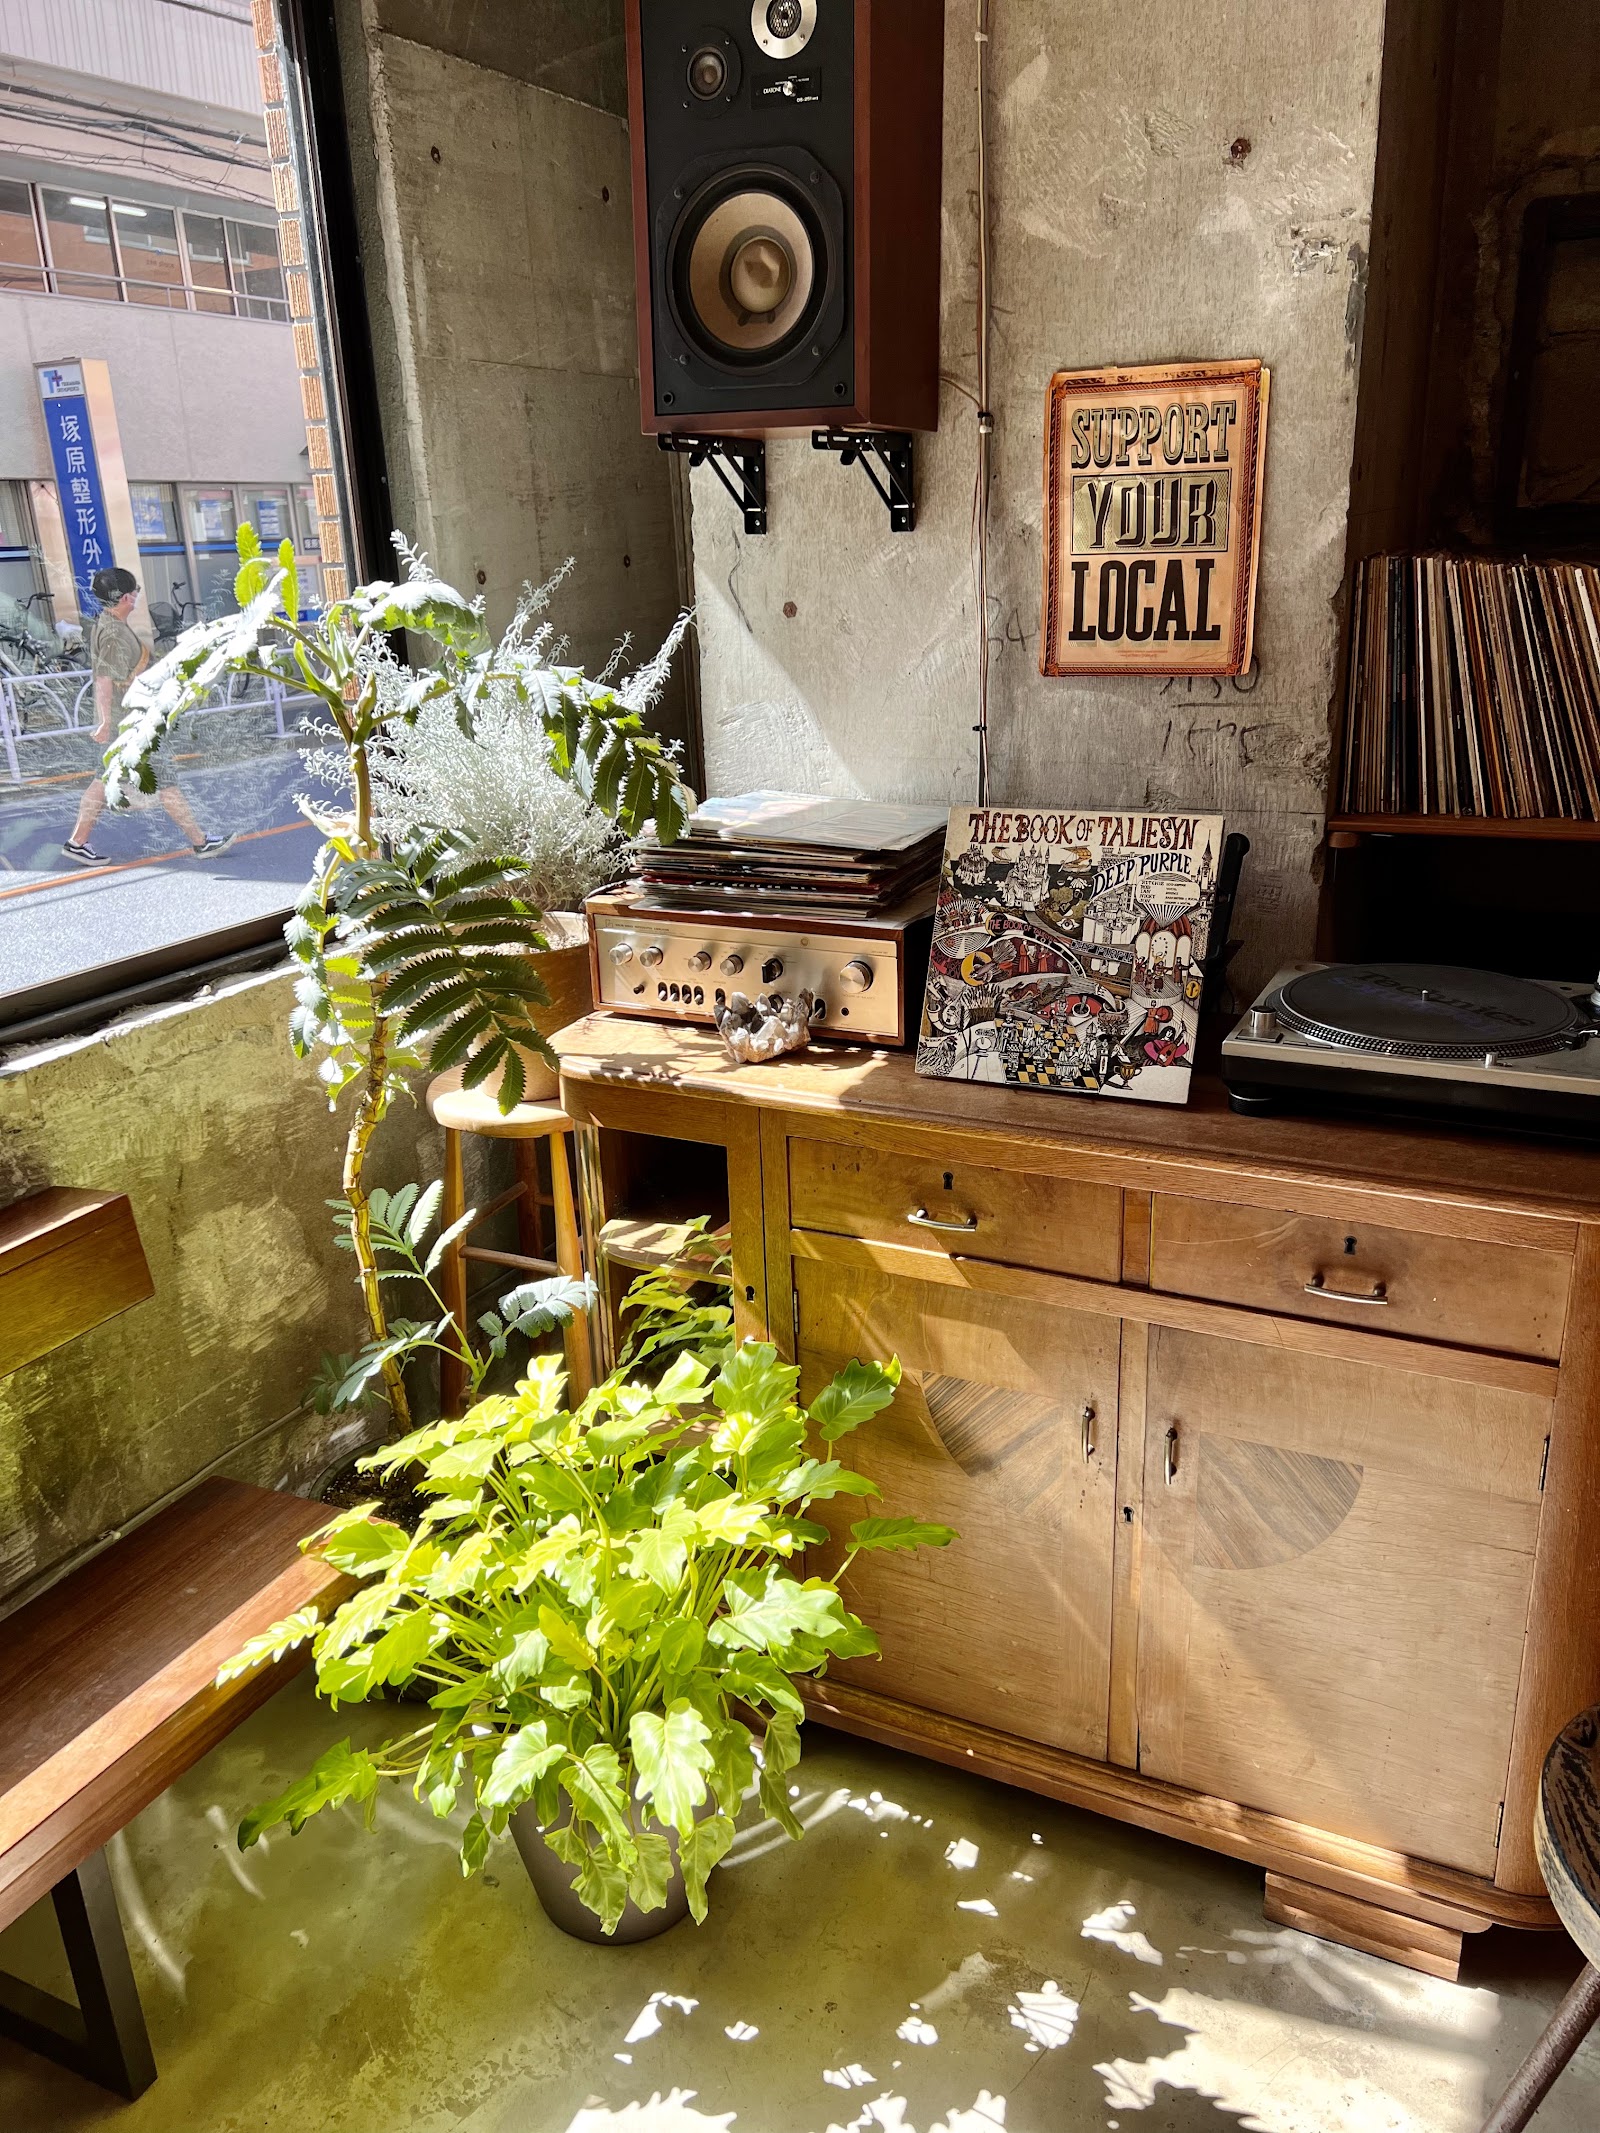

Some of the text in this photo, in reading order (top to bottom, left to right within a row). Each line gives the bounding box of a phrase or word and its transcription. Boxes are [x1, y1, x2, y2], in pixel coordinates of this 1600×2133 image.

[1071, 400, 1236, 469] SUPPORT
[1084, 476, 1218, 549] YOUR
[1068, 558, 1221, 642] LOCAL
[968, 811, 1201, 850] THE BOOK OF TALIESYN
[1092, 857, 1136, 898] DEEP
[1139, 852, 1192, 876] PURPLE
[988, 919, 1001, 930] THE
[1003, 920, 1023, 931] BOOK
[1353, 970, 1535, 1026] Technics
